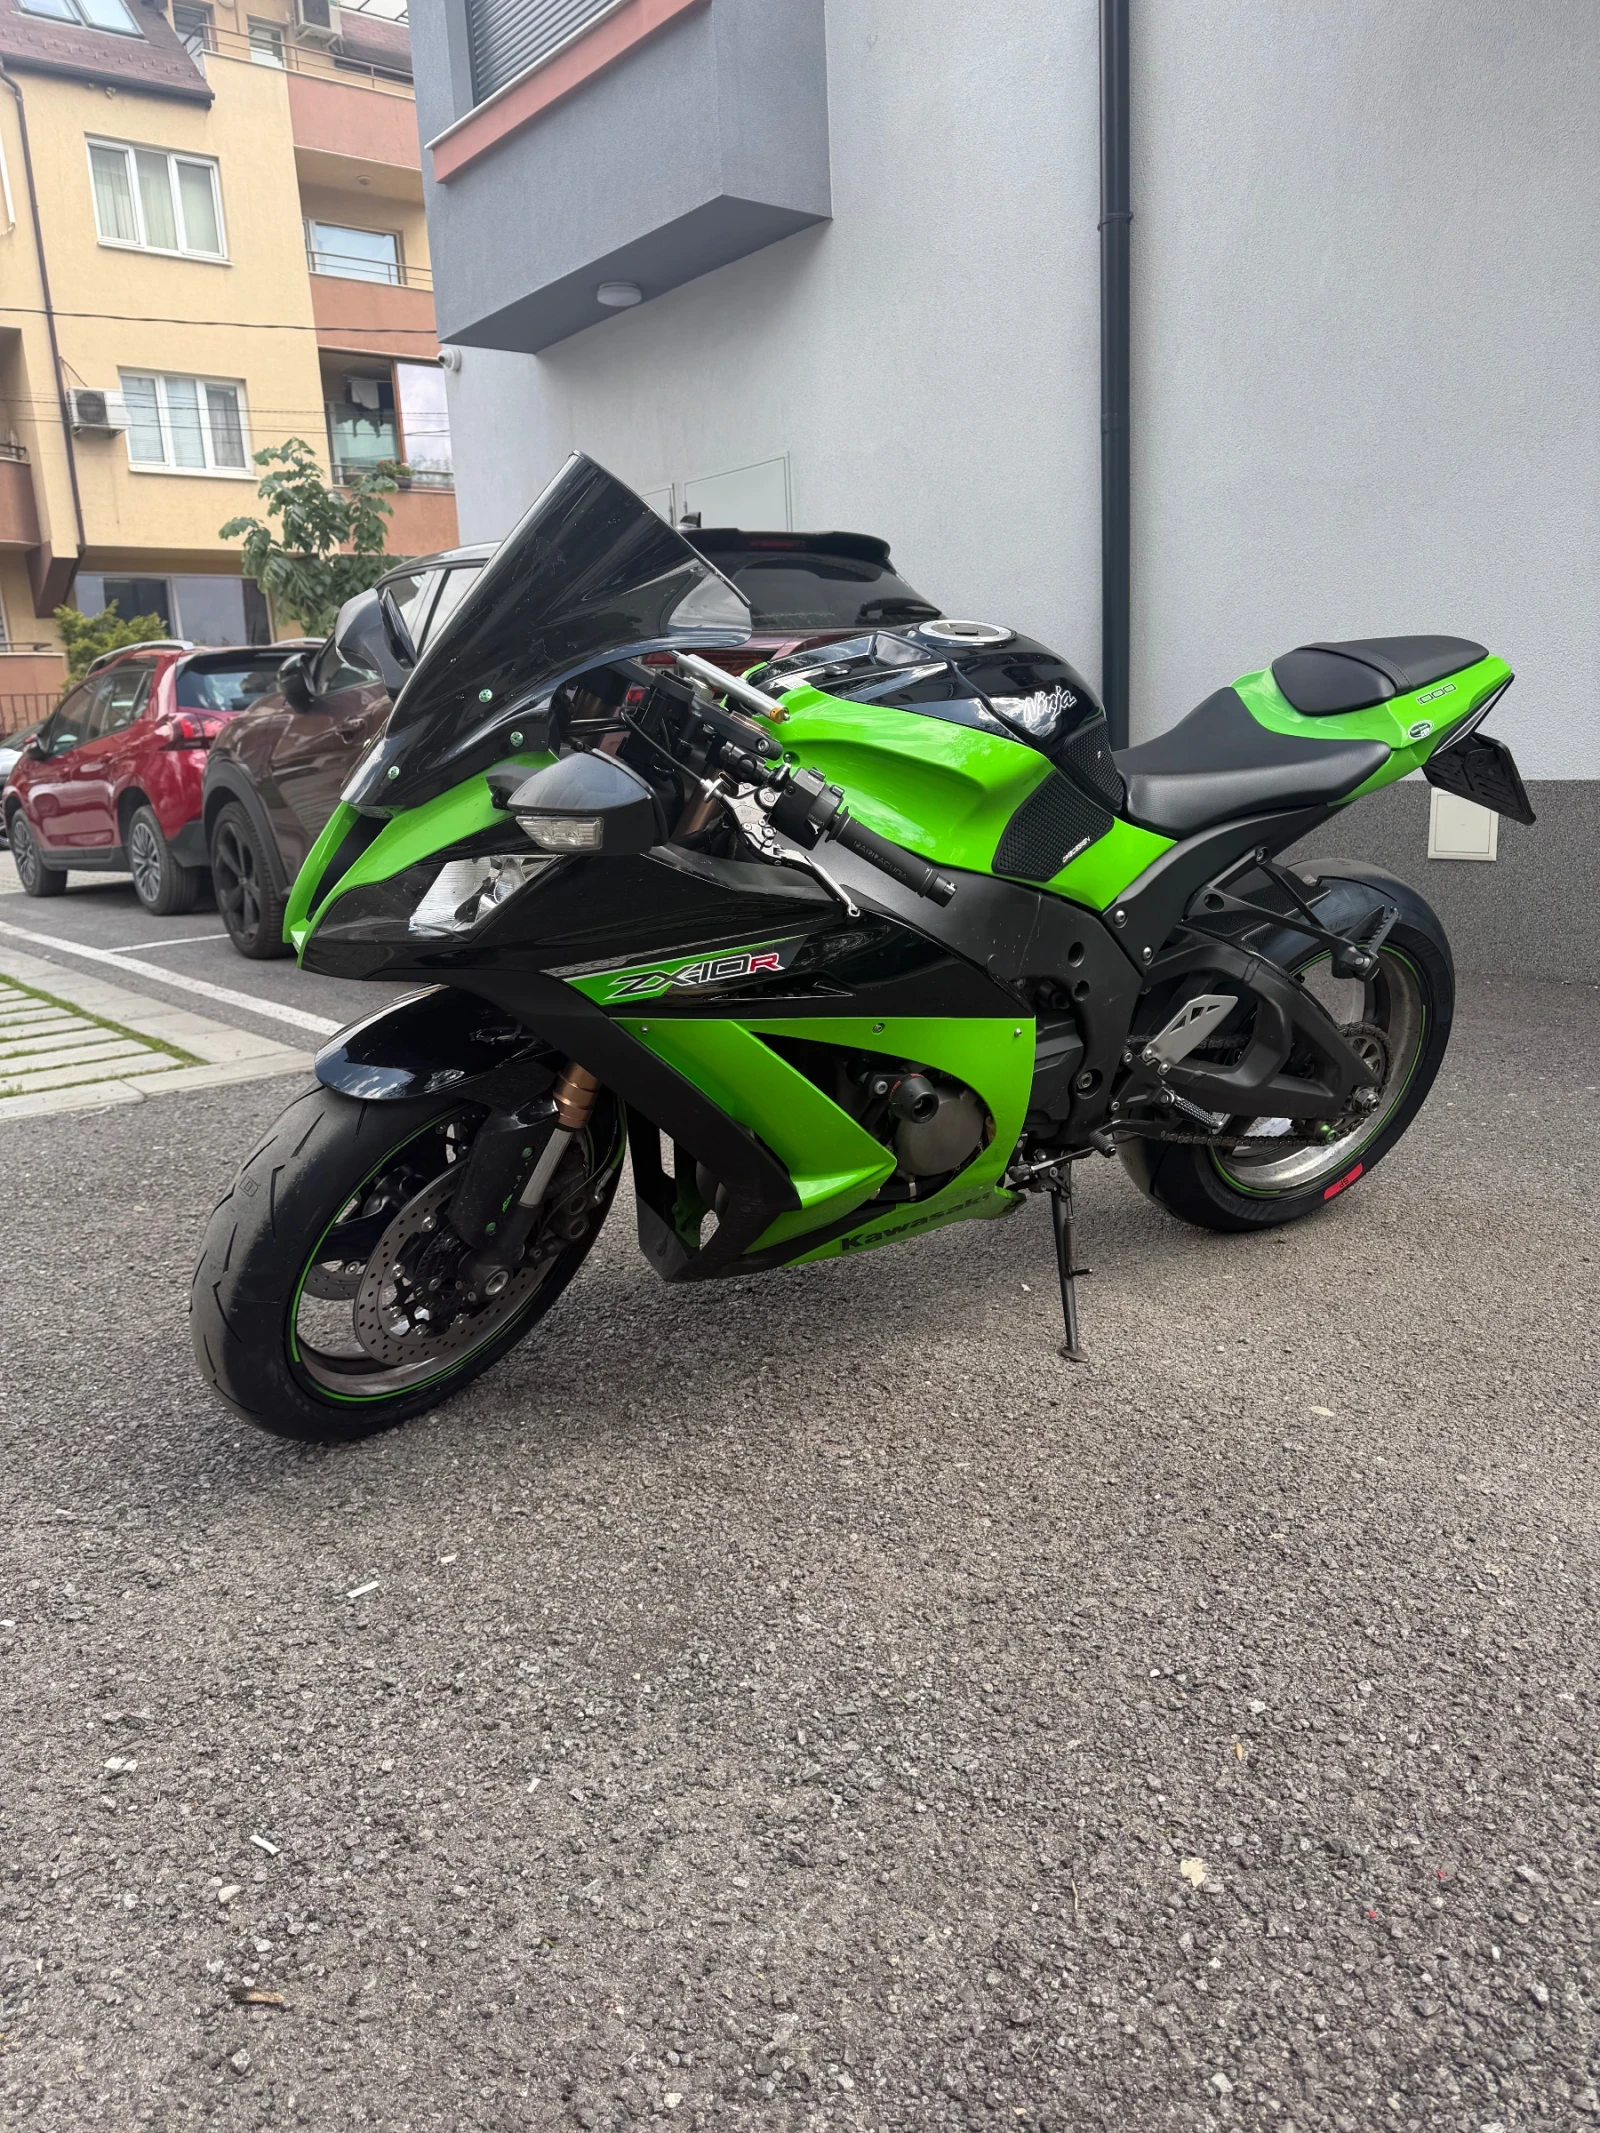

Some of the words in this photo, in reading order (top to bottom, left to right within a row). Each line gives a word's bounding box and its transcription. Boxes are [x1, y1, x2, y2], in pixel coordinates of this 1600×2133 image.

[1023, 684, 1077, 723] Ninja
[1416, 683, 1458, 705] 1000
[841, 1191, 991, 1251] Kawasaki
